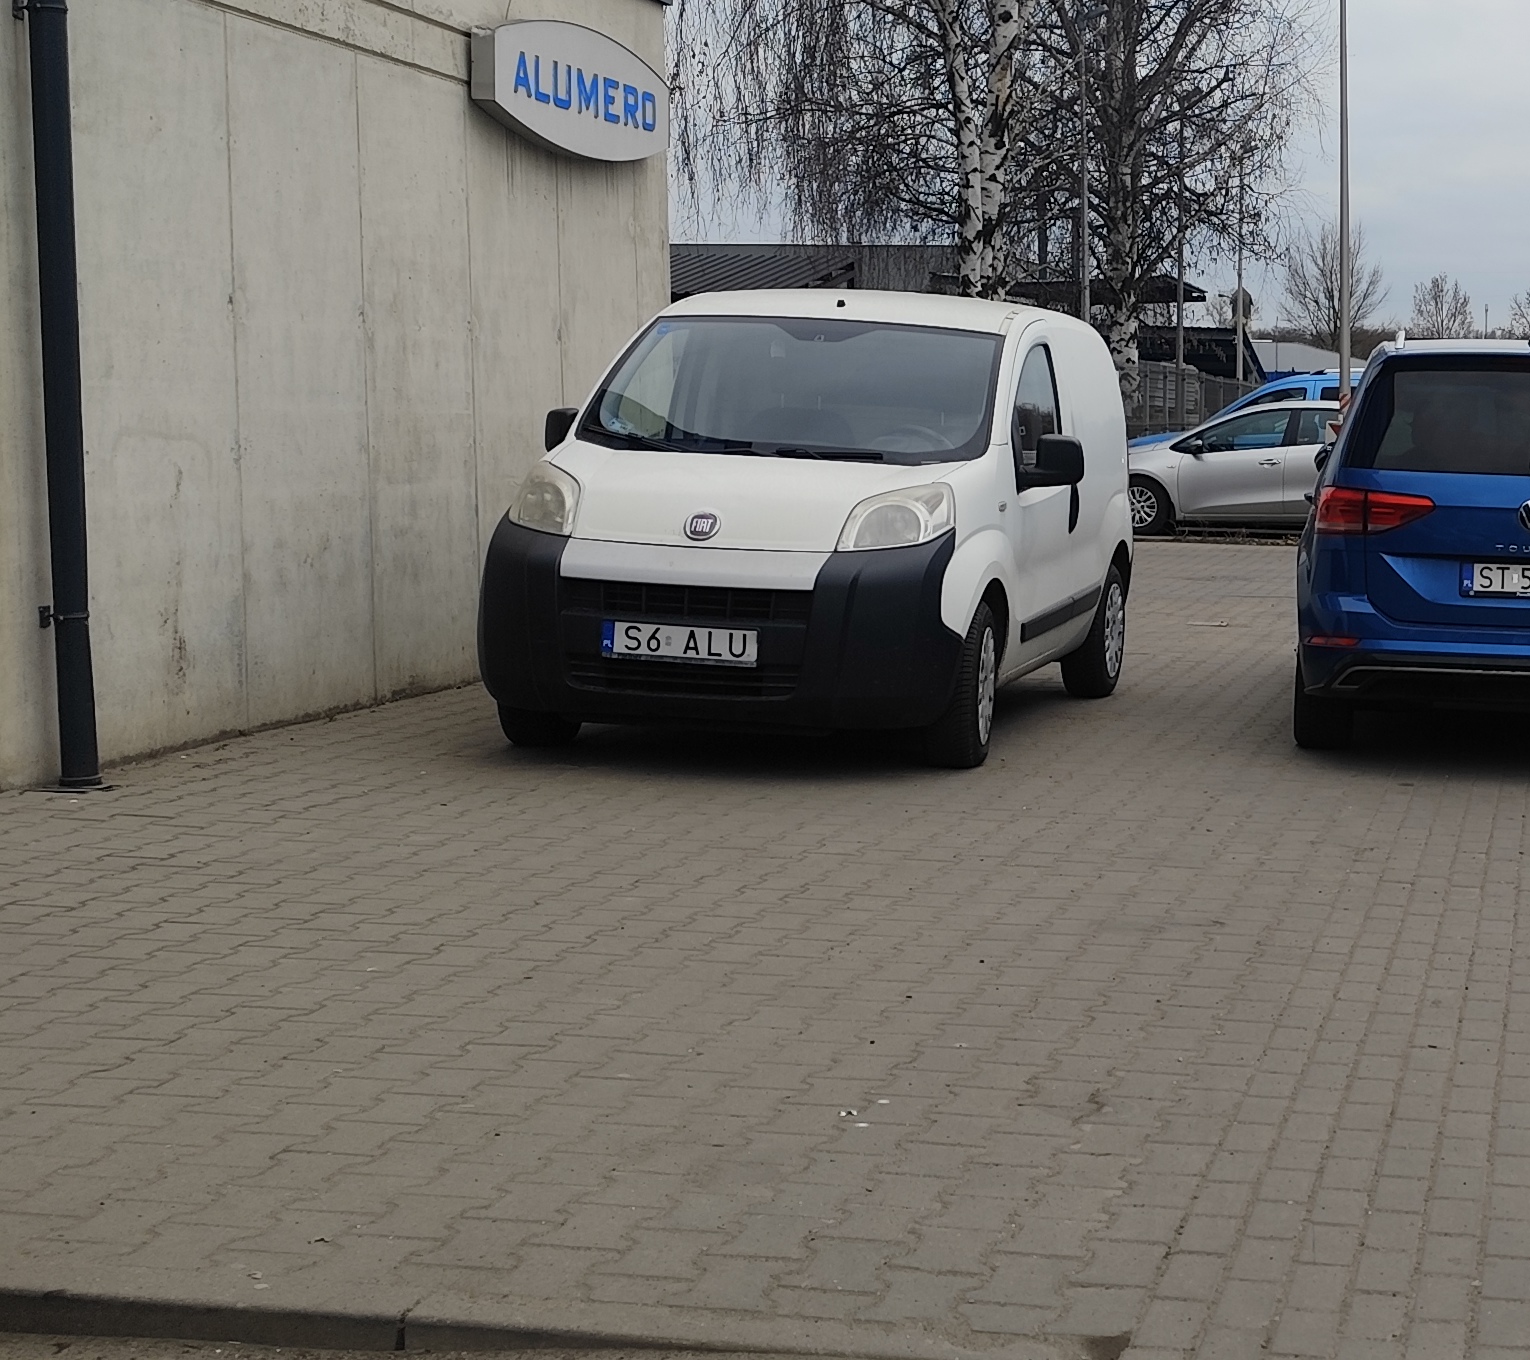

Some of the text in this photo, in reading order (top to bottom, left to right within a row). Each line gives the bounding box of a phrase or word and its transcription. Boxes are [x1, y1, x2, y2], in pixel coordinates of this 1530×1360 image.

[513, 51, 657, 133] ALUMERO
[691, 518, 714, 533] FIAT
[1463, 580, 1472, 588] PL
[1479, 566, 1510, 589] ST
[602, 639, 612, 648] PL
[624, 625, 747, 658] S6 ALU
